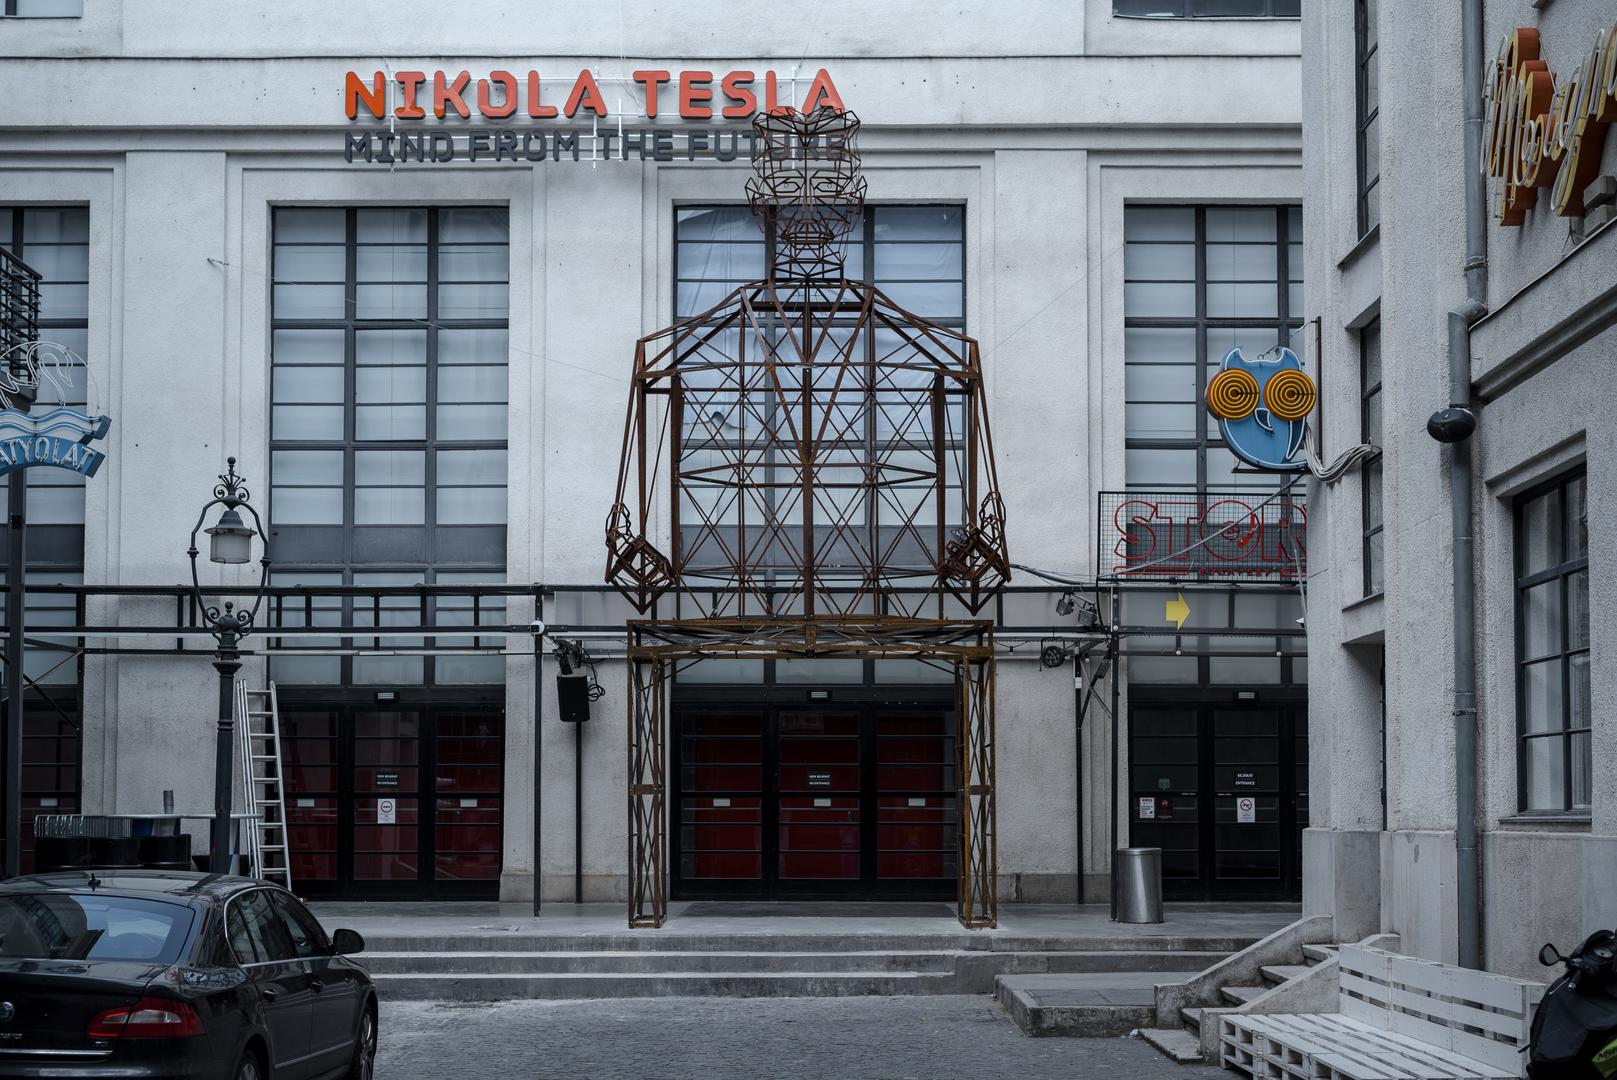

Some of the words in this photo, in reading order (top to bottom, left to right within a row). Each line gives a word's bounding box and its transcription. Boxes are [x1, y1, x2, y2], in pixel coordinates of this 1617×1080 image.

[345, 69, 608, 120] NIKOLA
[633, 68, 846, 120] TESLA
[344, 130, 454, 163] MIND
[468, 129, 580, 162] FROM
[596, 128, 673, 162] THE
[687, 129, 842, 163] FUTURE
[1114, 500, 1307, 561] STOR
